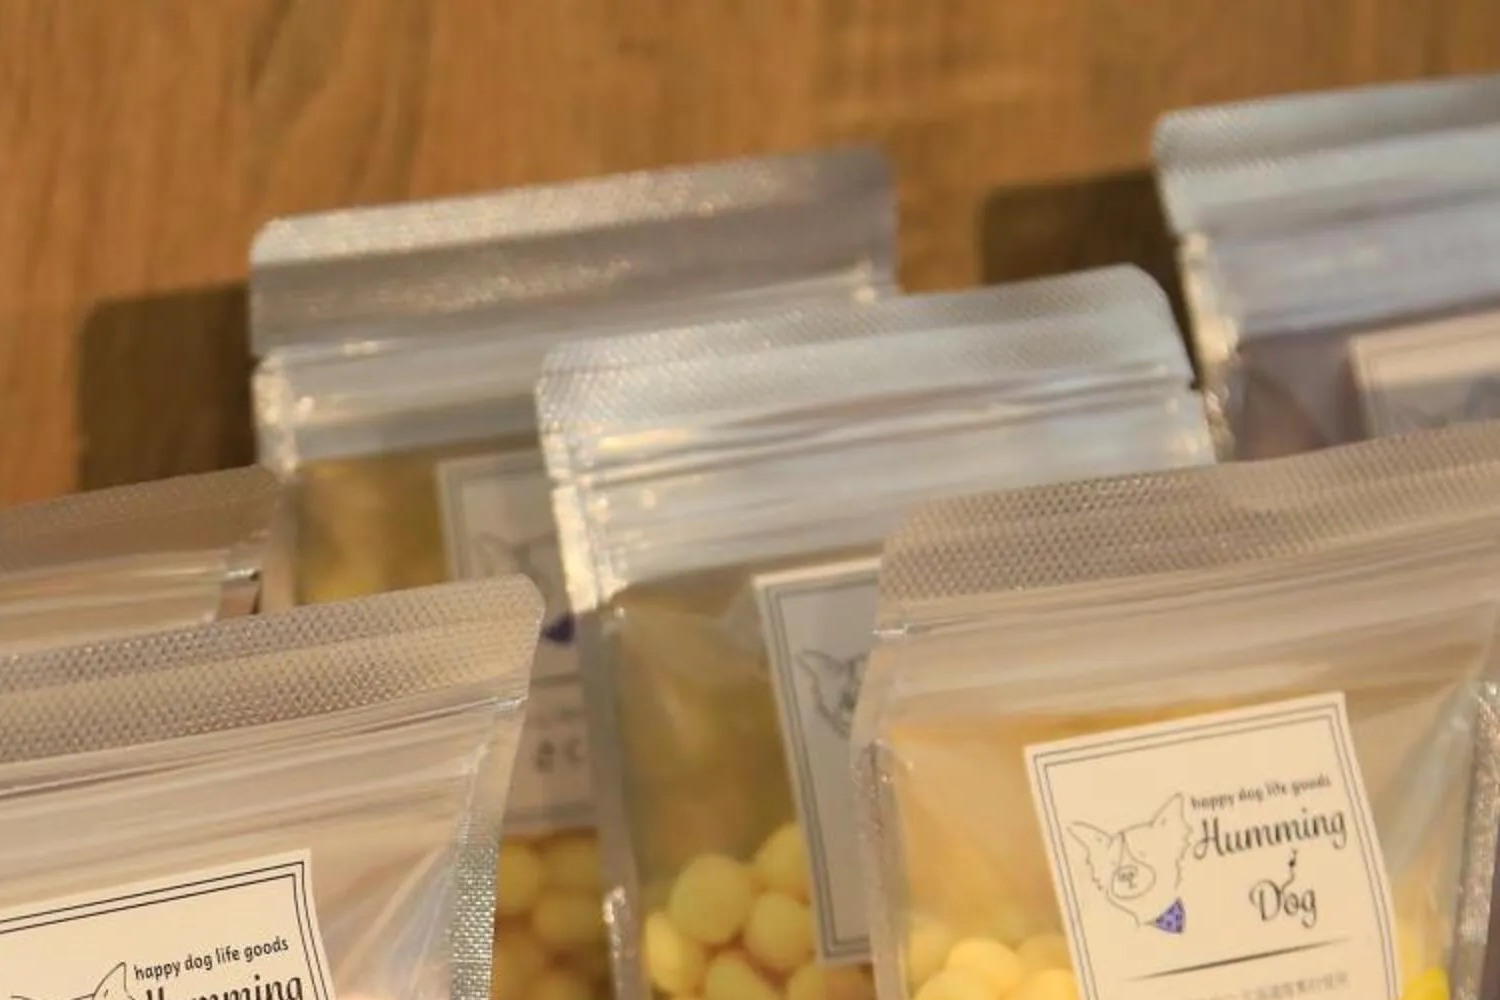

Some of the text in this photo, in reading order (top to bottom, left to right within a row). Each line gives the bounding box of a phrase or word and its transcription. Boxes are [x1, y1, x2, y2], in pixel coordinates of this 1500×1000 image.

[1193, 806, 1348, 861] Humming
[1248, 868, 1318, 929] Dog
[133, 936, 289, 982] happy dog life goods
